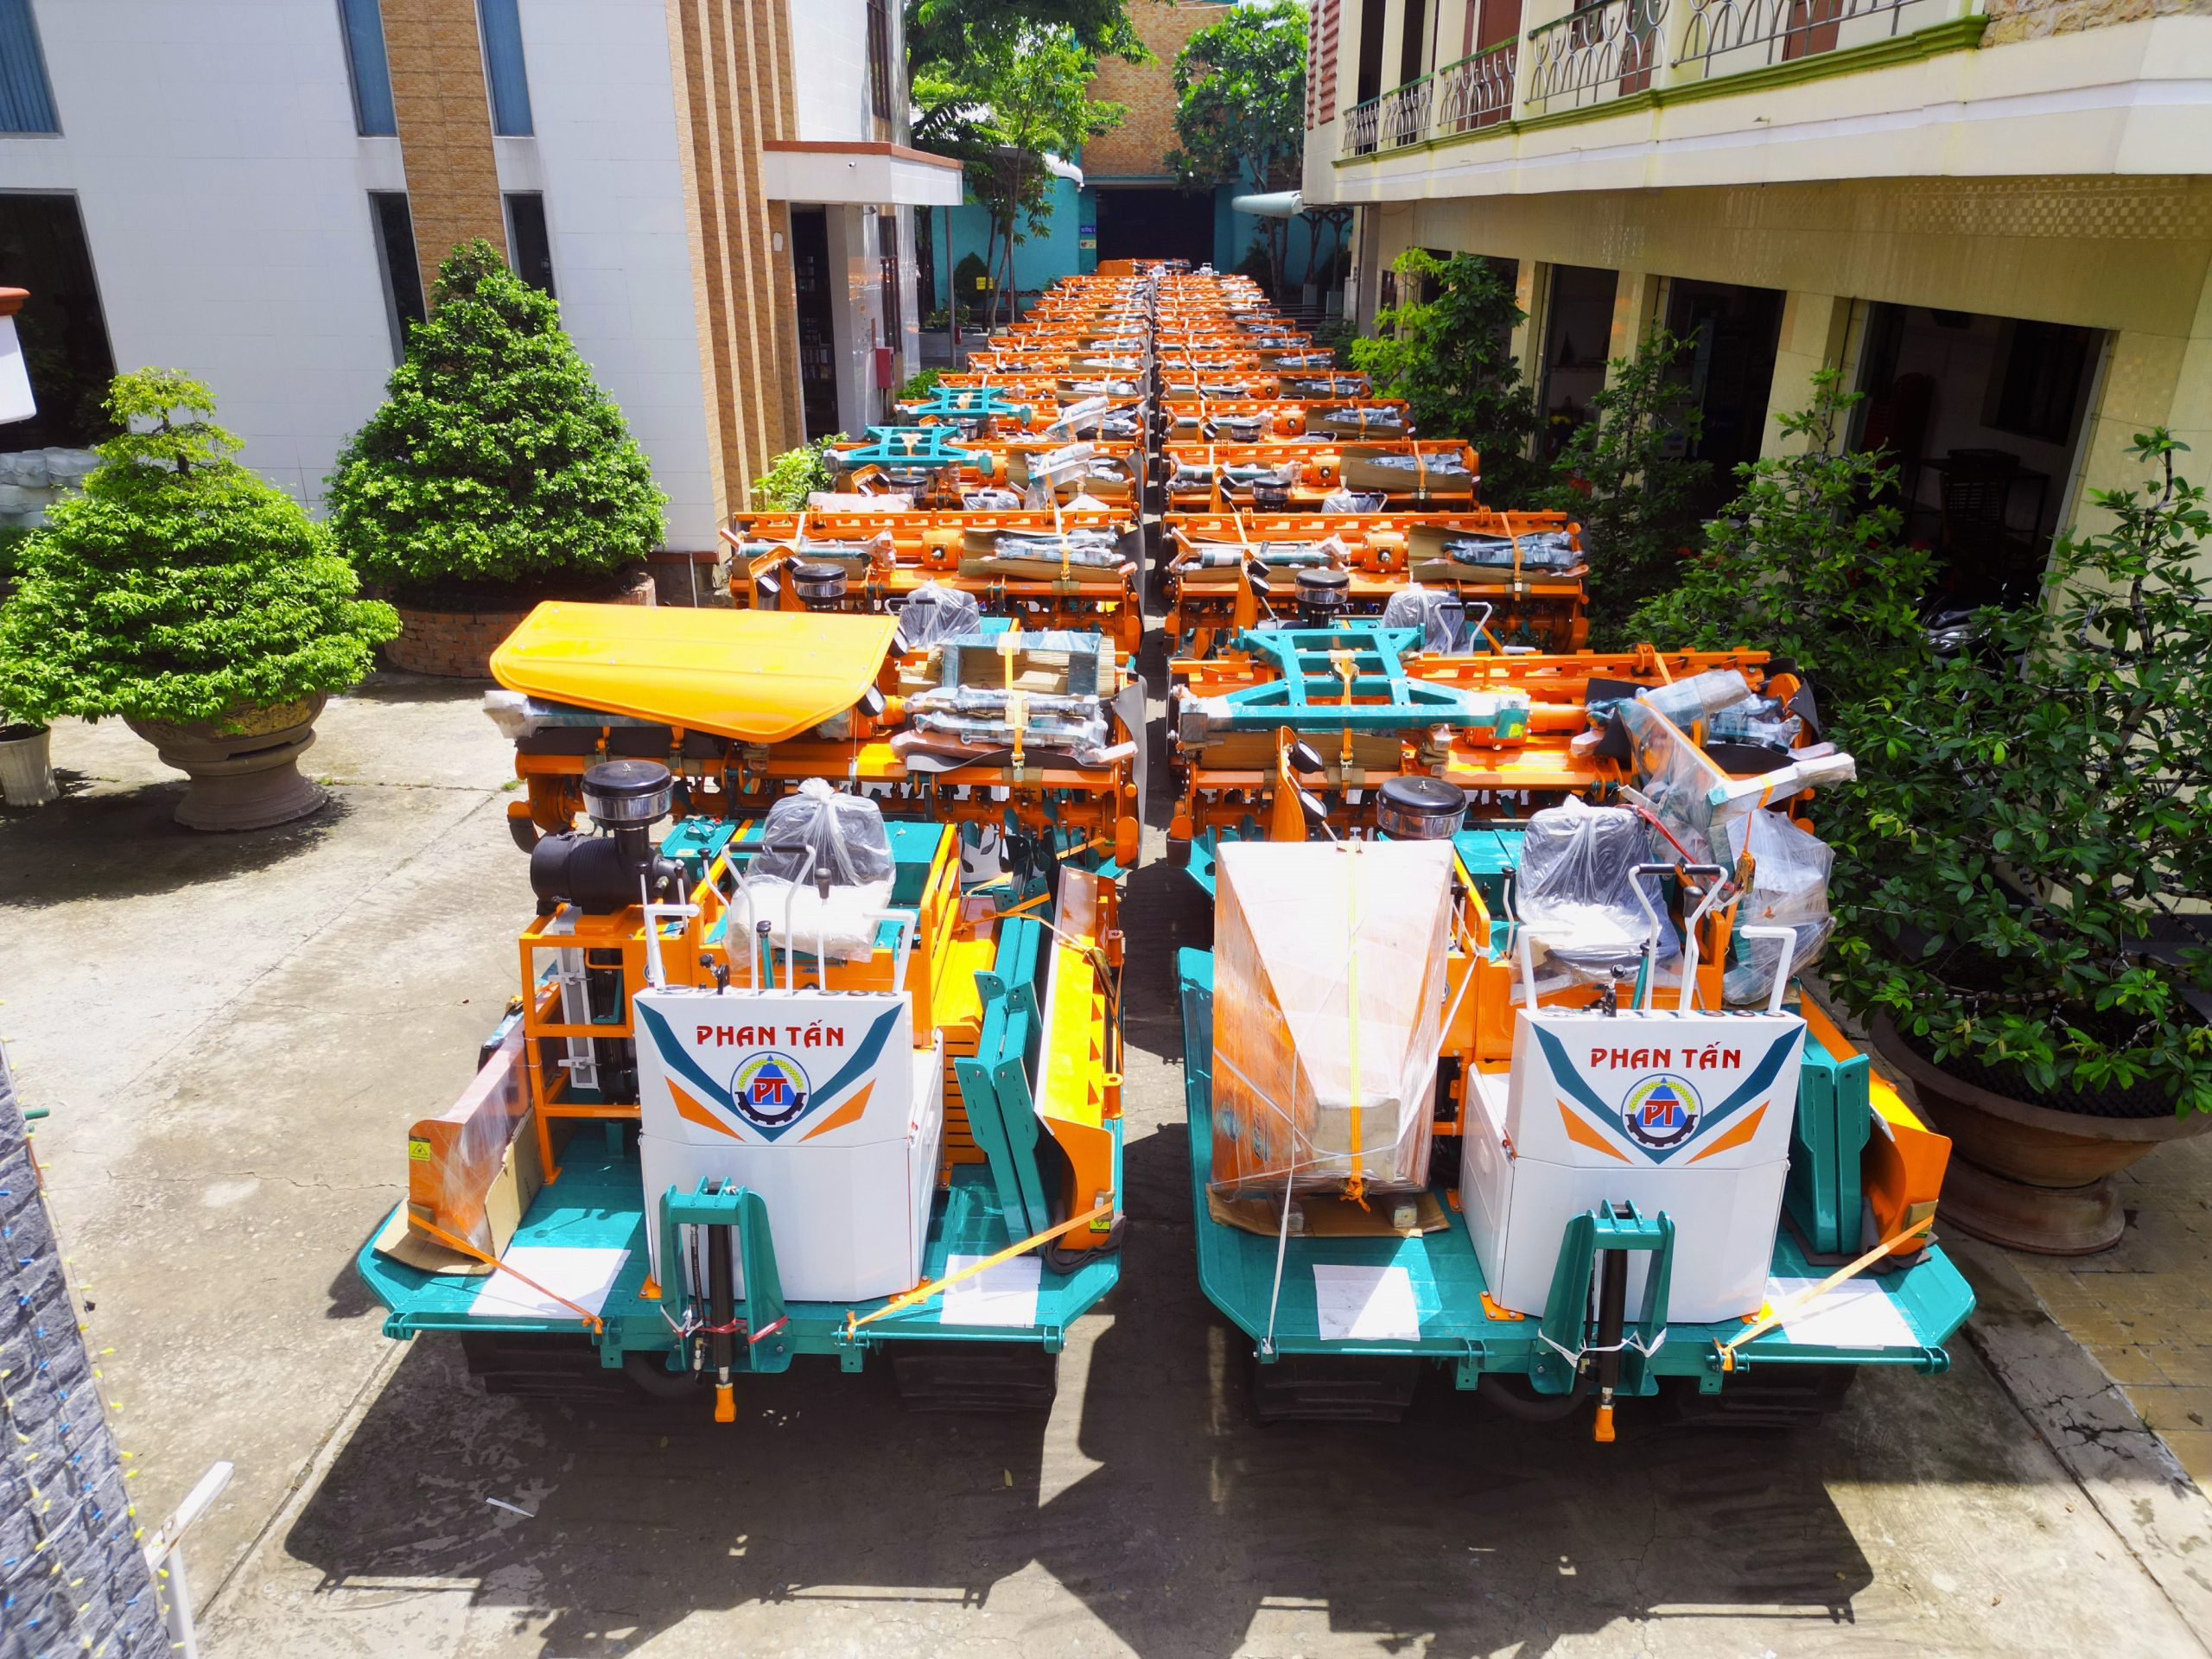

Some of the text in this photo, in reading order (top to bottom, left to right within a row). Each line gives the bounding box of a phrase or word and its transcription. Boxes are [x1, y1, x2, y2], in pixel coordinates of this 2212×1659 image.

[696, 1020, 844, 1048] PHAN TẤN
[1591, 1042, 1741, 1071] PHAN TẤN
[753, 1077, 788, 1103] PT
[1644, 1099, 1680, 1126] PT
